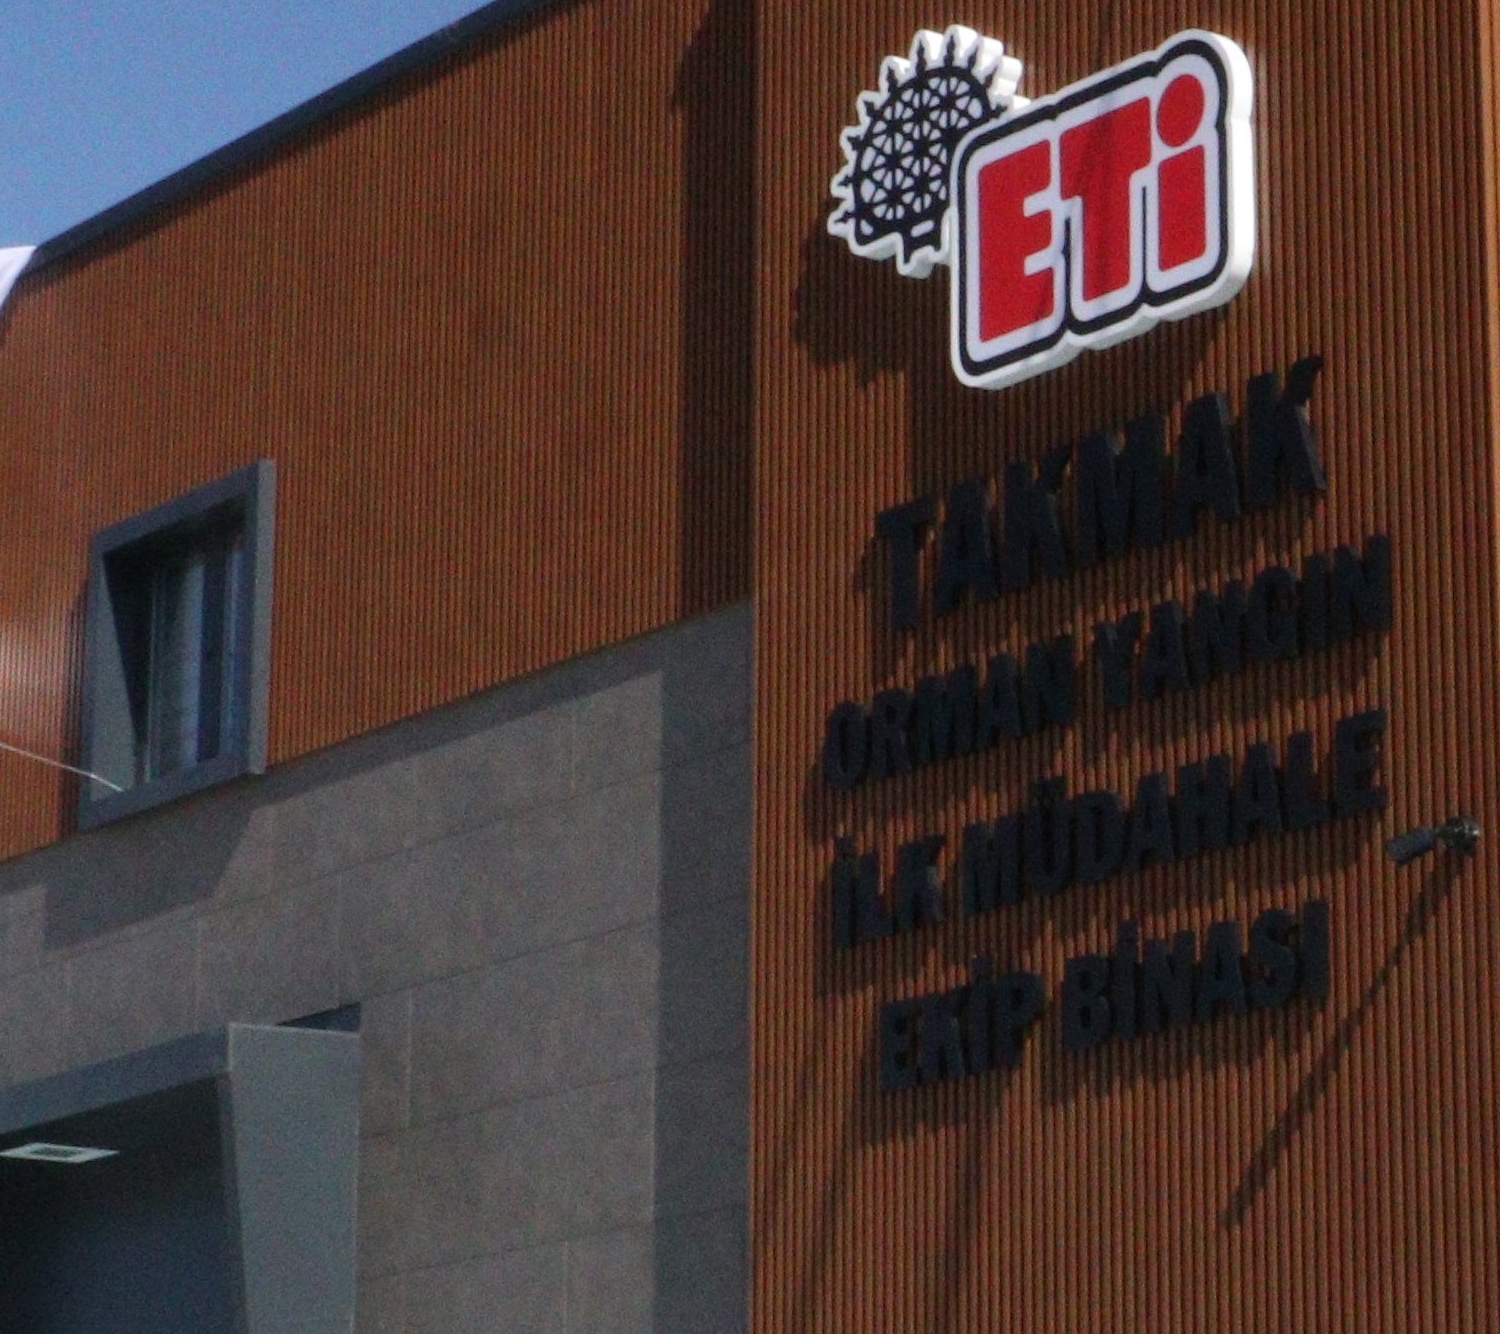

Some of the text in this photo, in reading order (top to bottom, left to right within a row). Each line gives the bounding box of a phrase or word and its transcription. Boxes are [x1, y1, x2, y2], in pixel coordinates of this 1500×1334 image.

[874, 356, 1328, 629] TAKMAK
[822, 533, 1391, 791] ORMAN YANGIN
[962, 707, 1389, 917] MÜDAHALE
[879, 899, 1330, 1095] EKİP BİNASI
